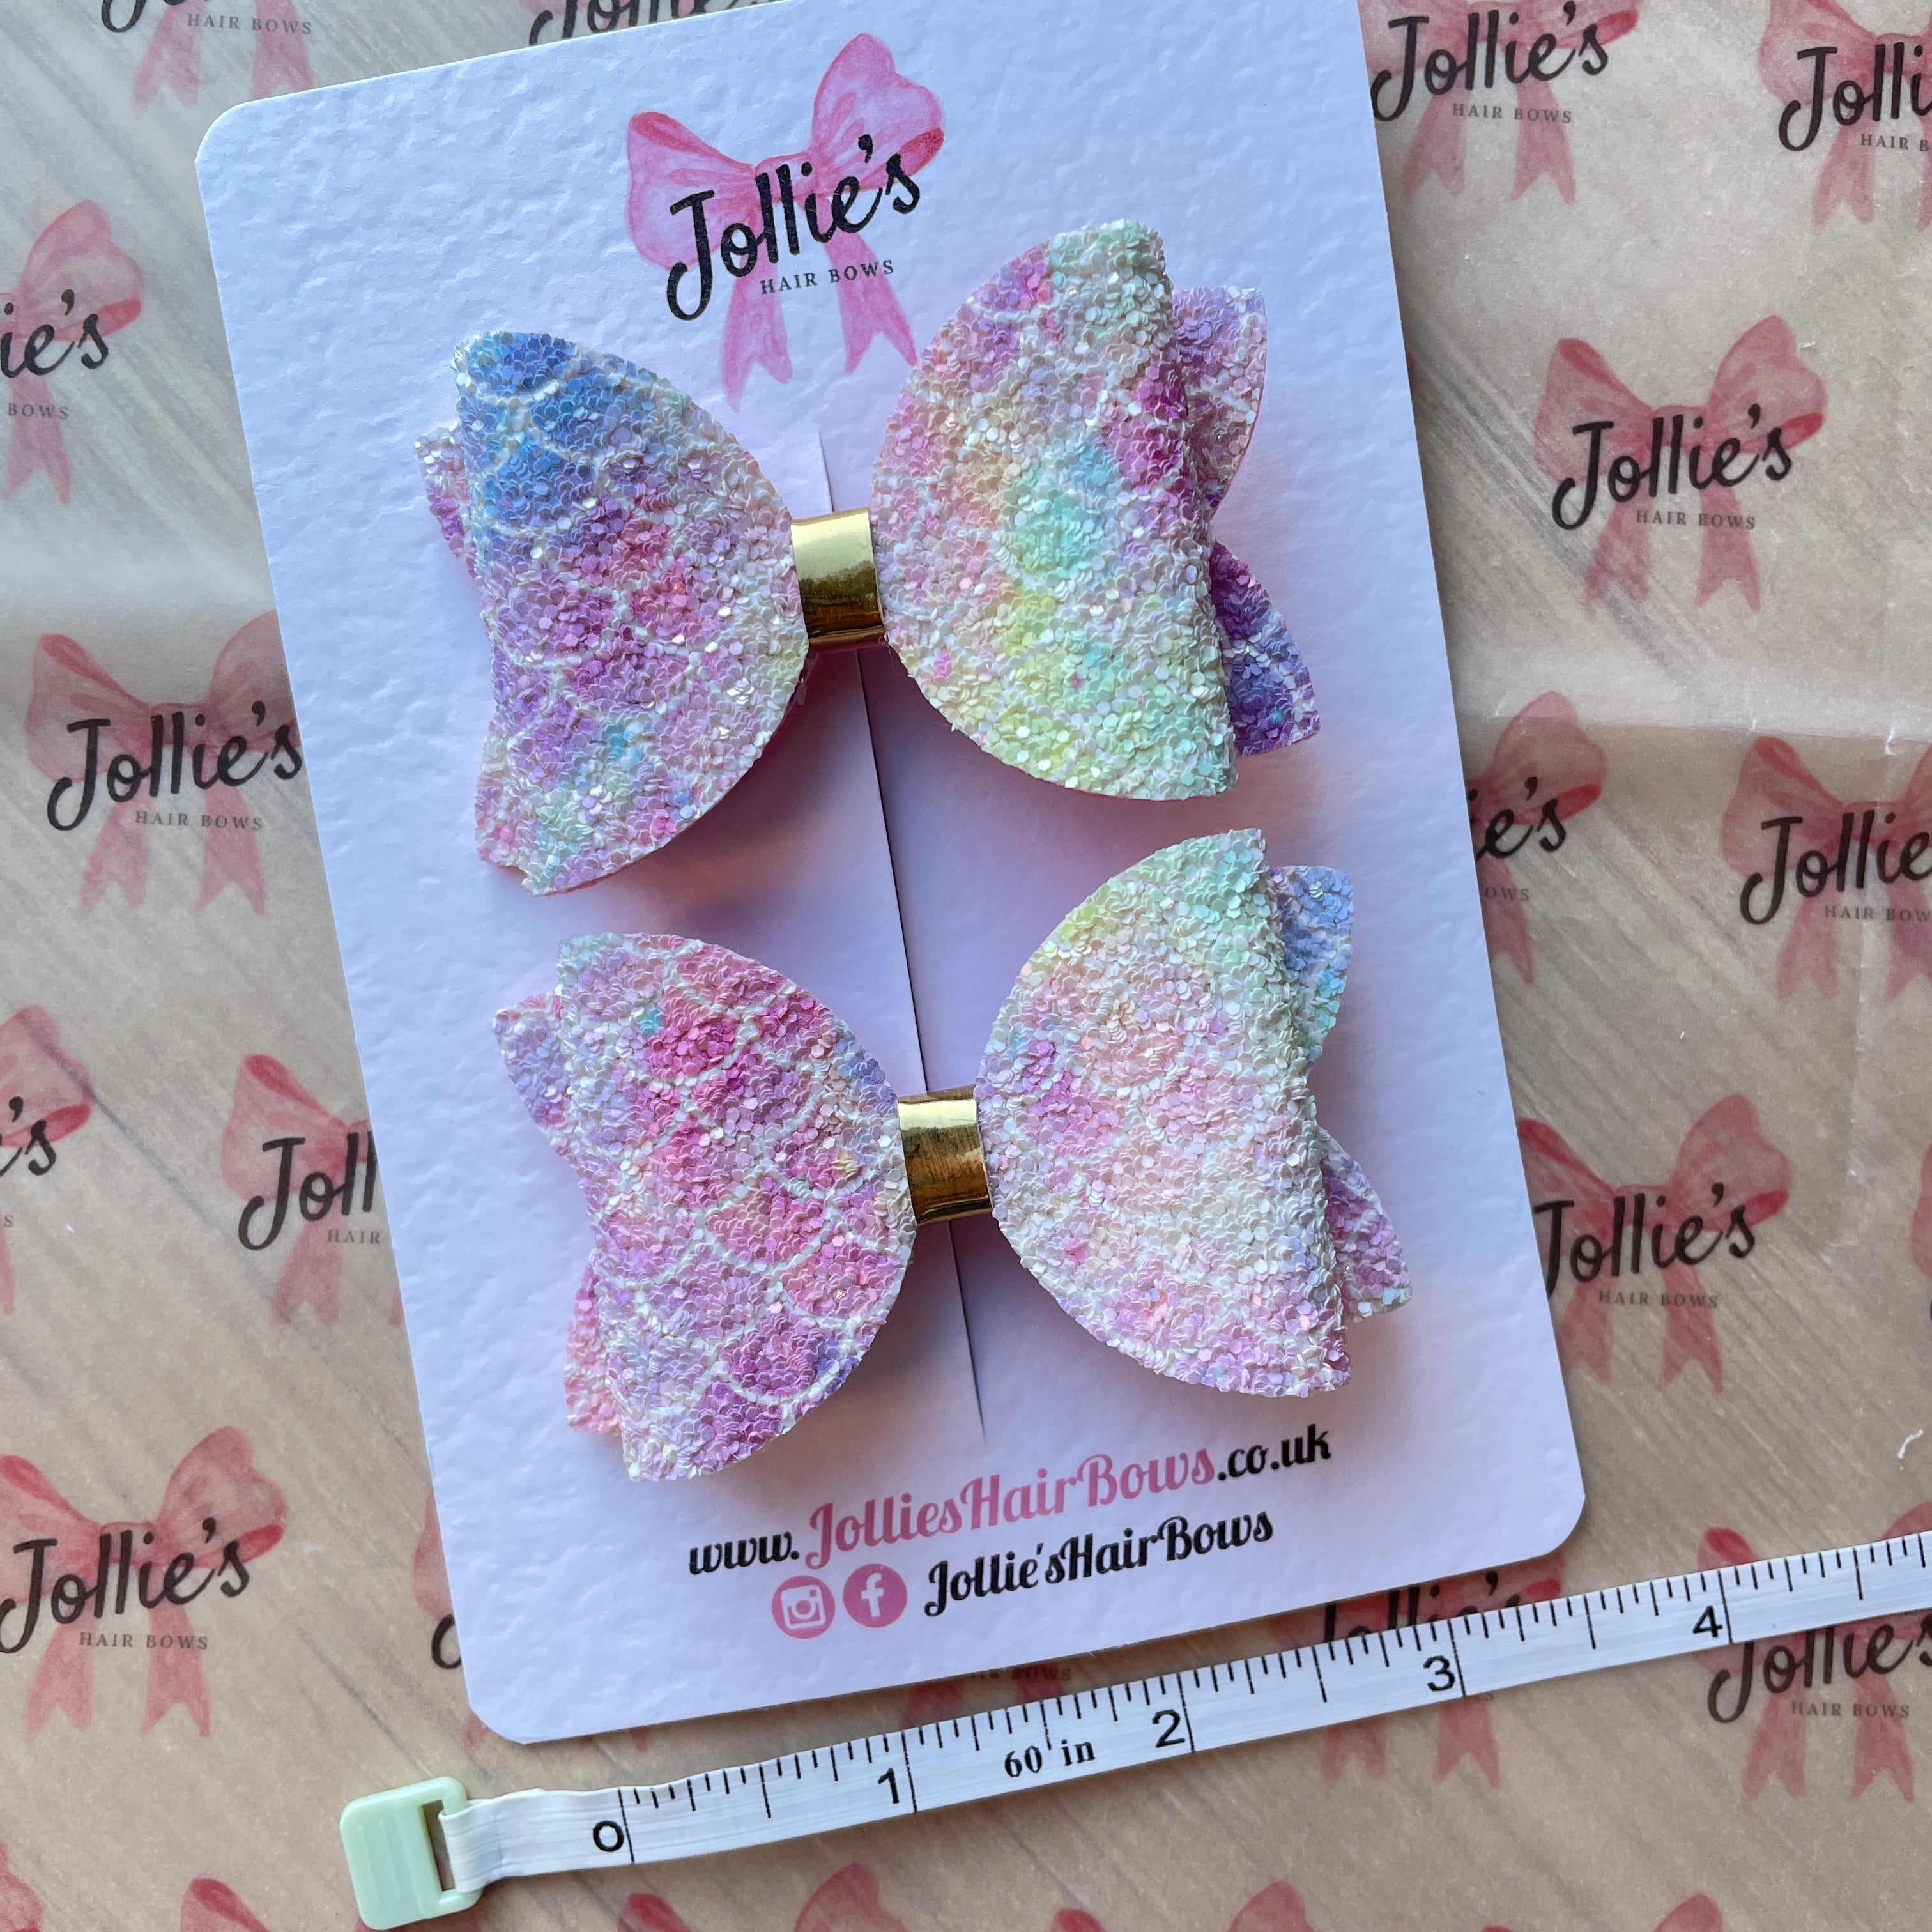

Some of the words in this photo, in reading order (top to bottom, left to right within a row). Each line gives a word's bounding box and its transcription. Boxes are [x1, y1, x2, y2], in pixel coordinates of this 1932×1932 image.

[187, 13, 240, 29] HAIR
[251, 19, 312, 35] BOWS
[1370, 0, 1608, 122] Jollie's
[1452, 103, 1503, 119] HAIR
[1514, 107, 1573, 124] BOWS
[1860, 133, 1909, 150] HAIR
[666, 134, 921, 321] Jollie's
[760, 272, 818, 295] HAIR
[829, 259, 895, 284] BOWS
[8, 402, 69, 420] BOWS
[1552, 404, 1791, 530] Jollie's
[1636, 510, 1687, 526] HAIR
[1698, 512, 1756, 530] BOWS
[47, 701, 303, 831] Jollie's
[134, 810, 188, 827] HAIR
[201, 814, 263, 831] BOWS
[1824, 905, 1874, 920] HAIR
[326, 1229, 381, 1245] HAIR
[1533, 1182, 1755, 1299] Jollie's
[1598, 1289, 1650, 1306] HAIR
[1661, 1292, 1719, 1310] BOWS
[689, 1423, 1332, 1575] www.JolliesHairBows.co.uk
[924, 1510, 1275, 1618] Jollie'sHairBows
[0, 1516, 250, 1653] Jollie's
[1693, 1605, 1723, 1638] 4
[79, 1631, 134, 1648] HAIR
[145, 1633, 209, 1651] BOWS
[1423, 1655, 1456, 1692] 3
[1791, 1701, 1842, 1717] HAIR
[1853, 1703, 1910, 1719] BOWS
[1152, 1708, 1186, 1749] 2
[1004, 1747, 1043, 1779] 60
[1062, 1738, 1096, 1765] in
[877, 1768, 900, 1805] 1
[593, 1820, 625, 1853] 0
